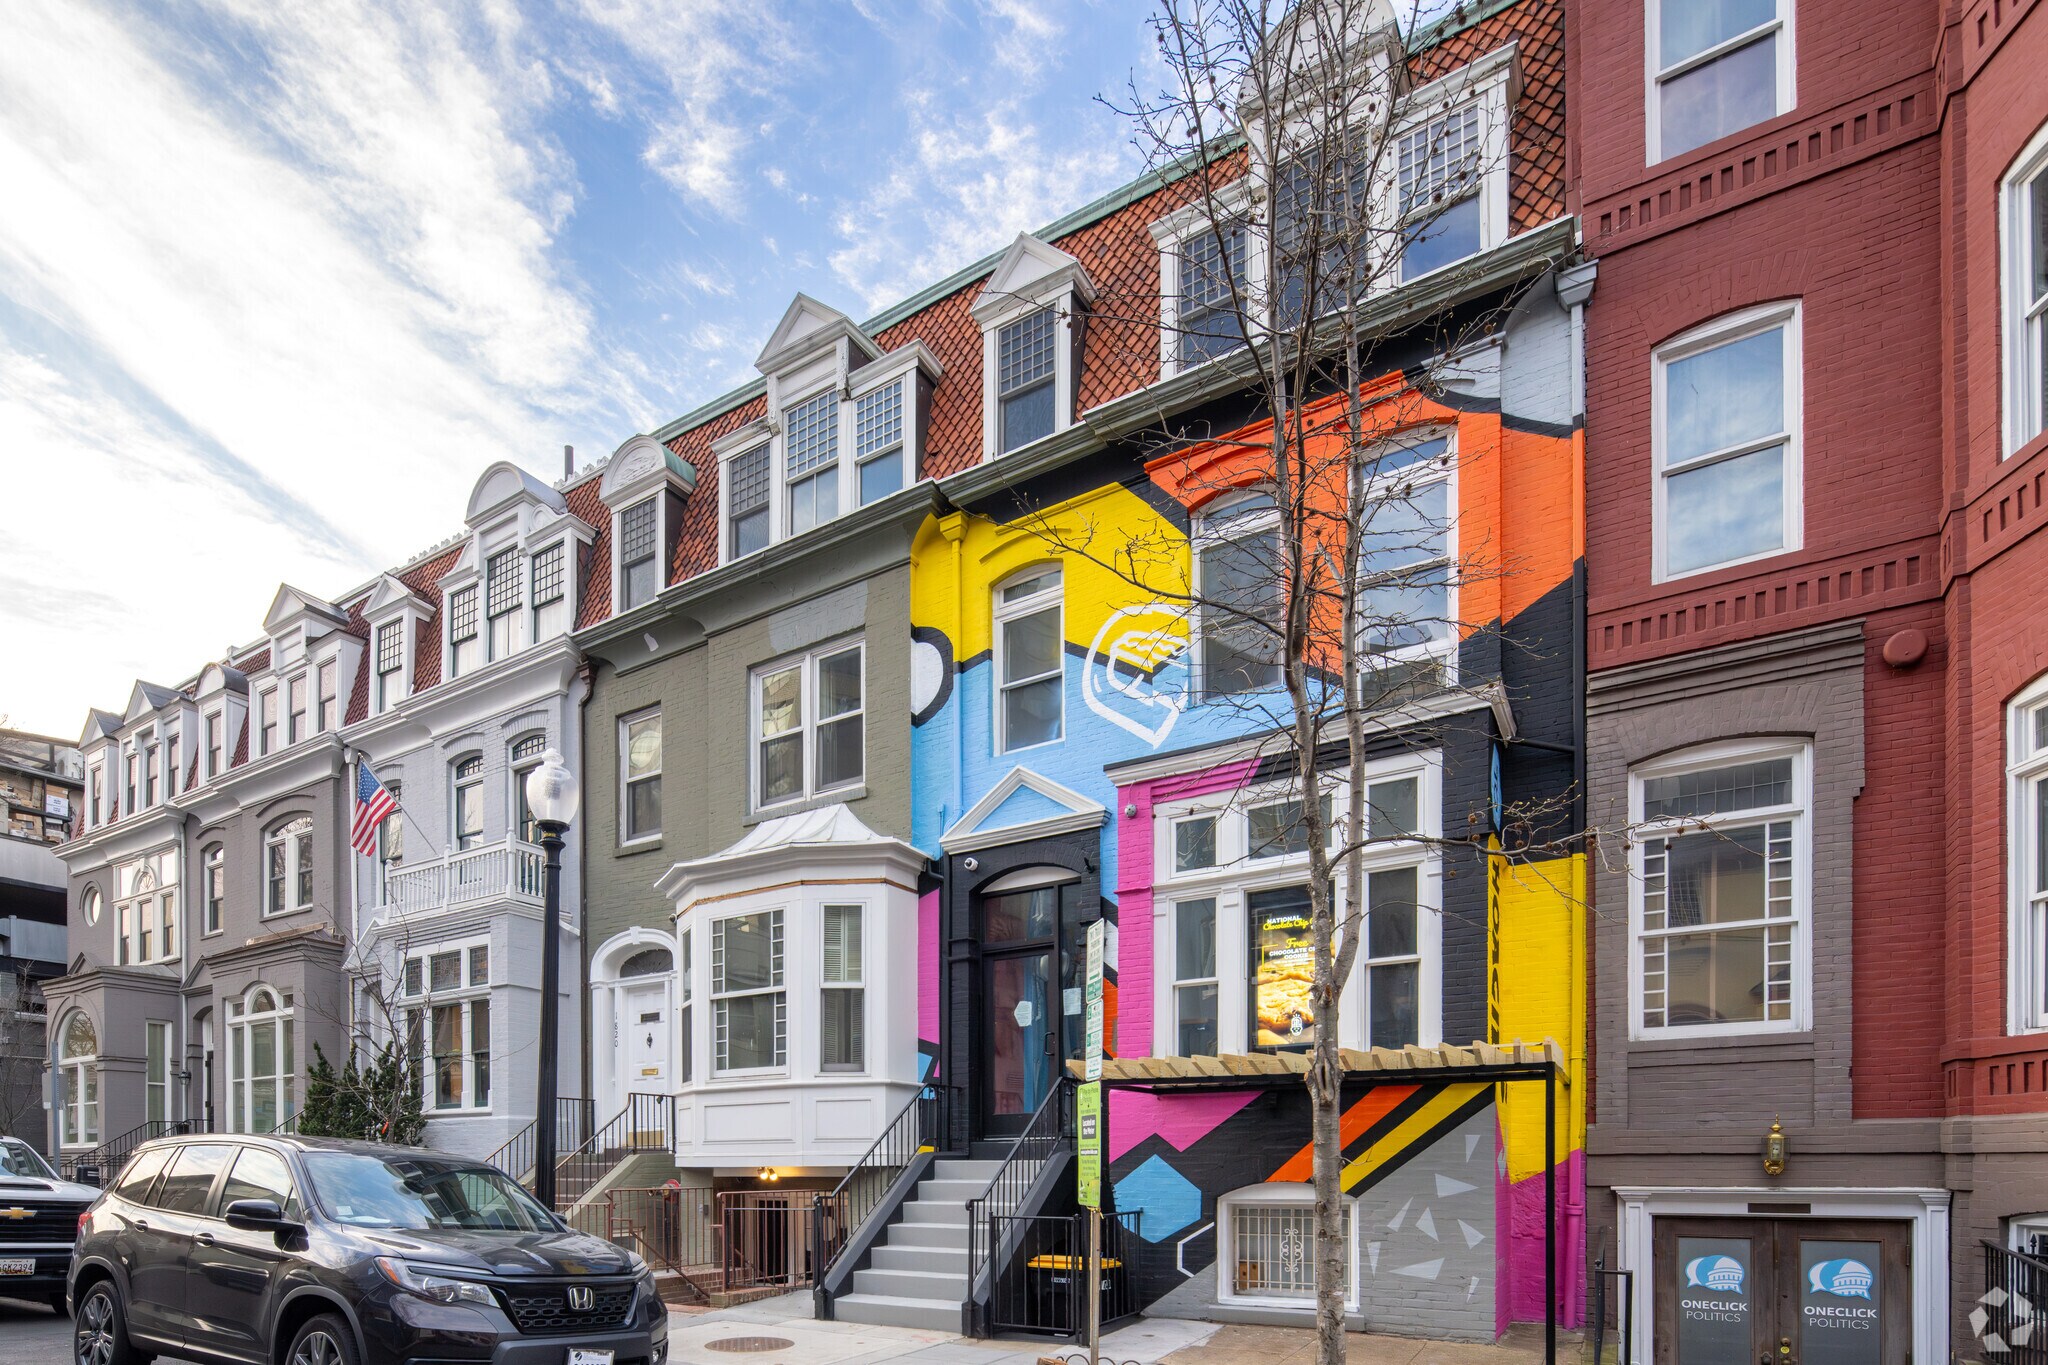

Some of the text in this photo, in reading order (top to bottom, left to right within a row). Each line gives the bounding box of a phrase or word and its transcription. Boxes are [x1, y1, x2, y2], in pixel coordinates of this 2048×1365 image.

[1267, 915, 1300, 924] NATIONAL
[1263, 921, 1293, 930] Chocolate
[1286, 937, 1309, 948] Free
[1269, 948, 1307, 956] CHOCOLATE
[1681, 1300, 1748, 1312] ONECLICK
[1686, 1310, 1741, 1323] POLITICS
[1804, 1306, 1877, 1318] ONECLICK
[1809, 1318, 1869, 1330] POLITICS
